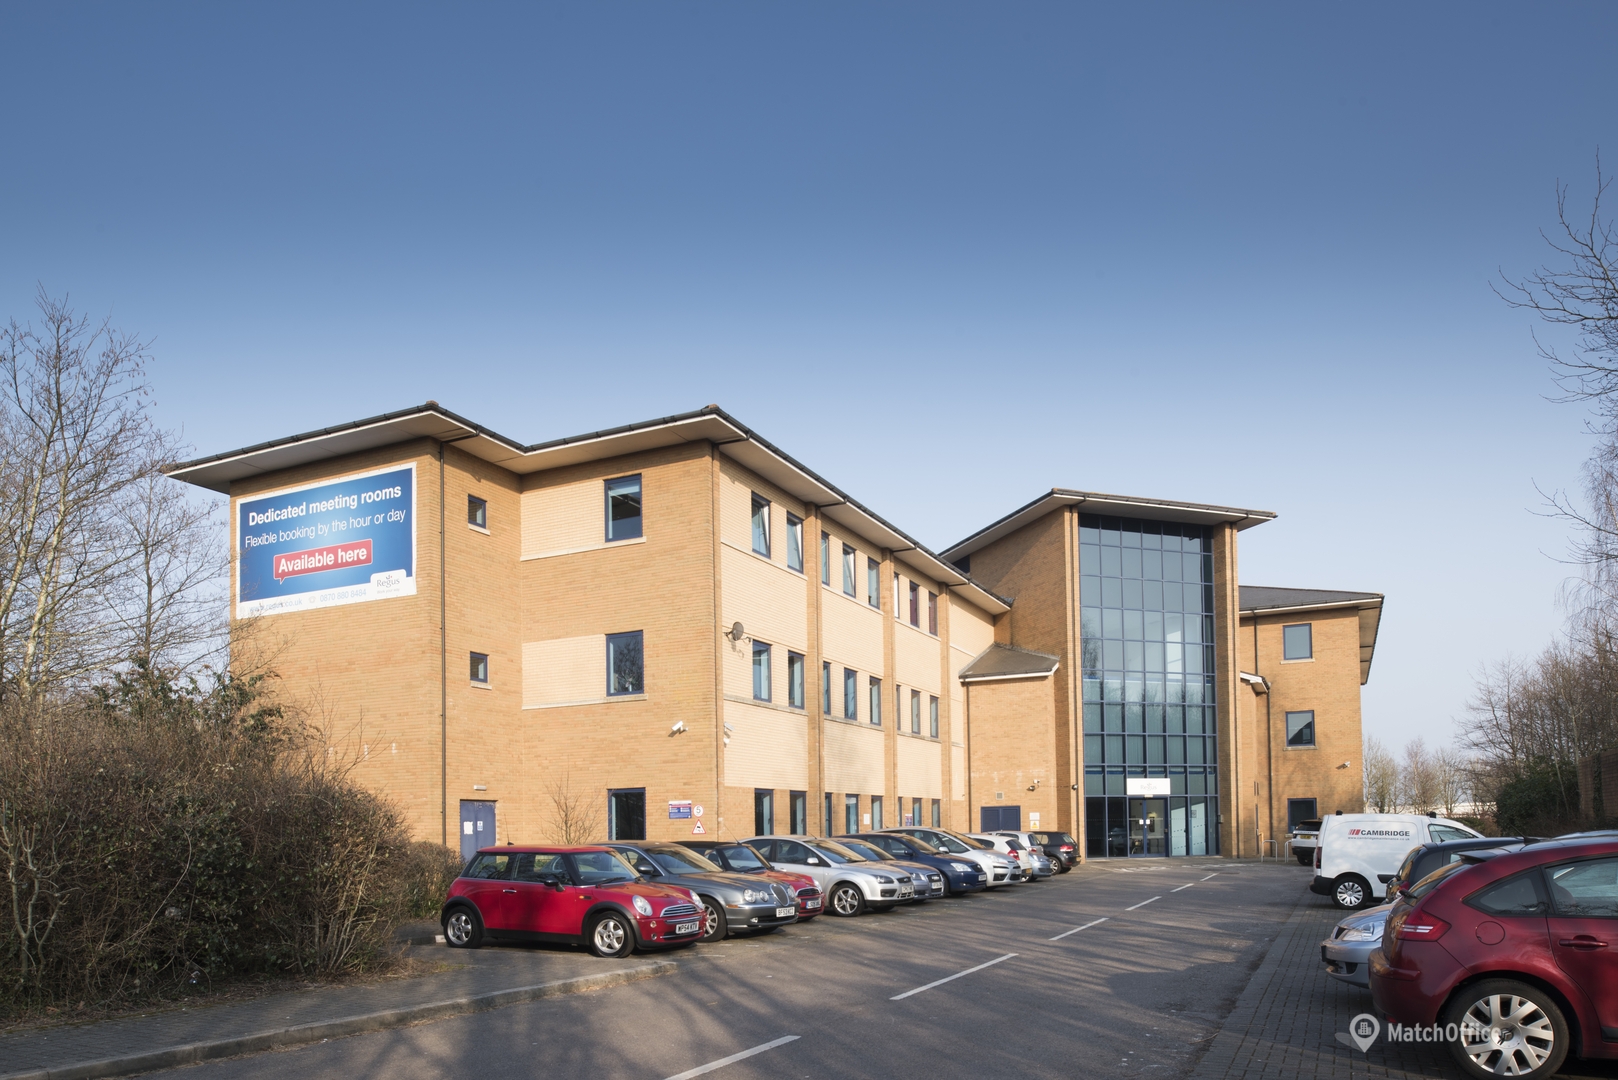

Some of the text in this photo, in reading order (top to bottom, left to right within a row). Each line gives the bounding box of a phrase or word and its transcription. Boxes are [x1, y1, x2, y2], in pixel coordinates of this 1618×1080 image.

[249, 486, 402, 526] Dedicated meeting rooms
[245, 508, 406, 548] Flexible booking by the hour or day
[278, 547, 367, 573] Available here
[319, 588, 367, 603] 0870 880 8484
[376, 578, 400, 588] Regus
